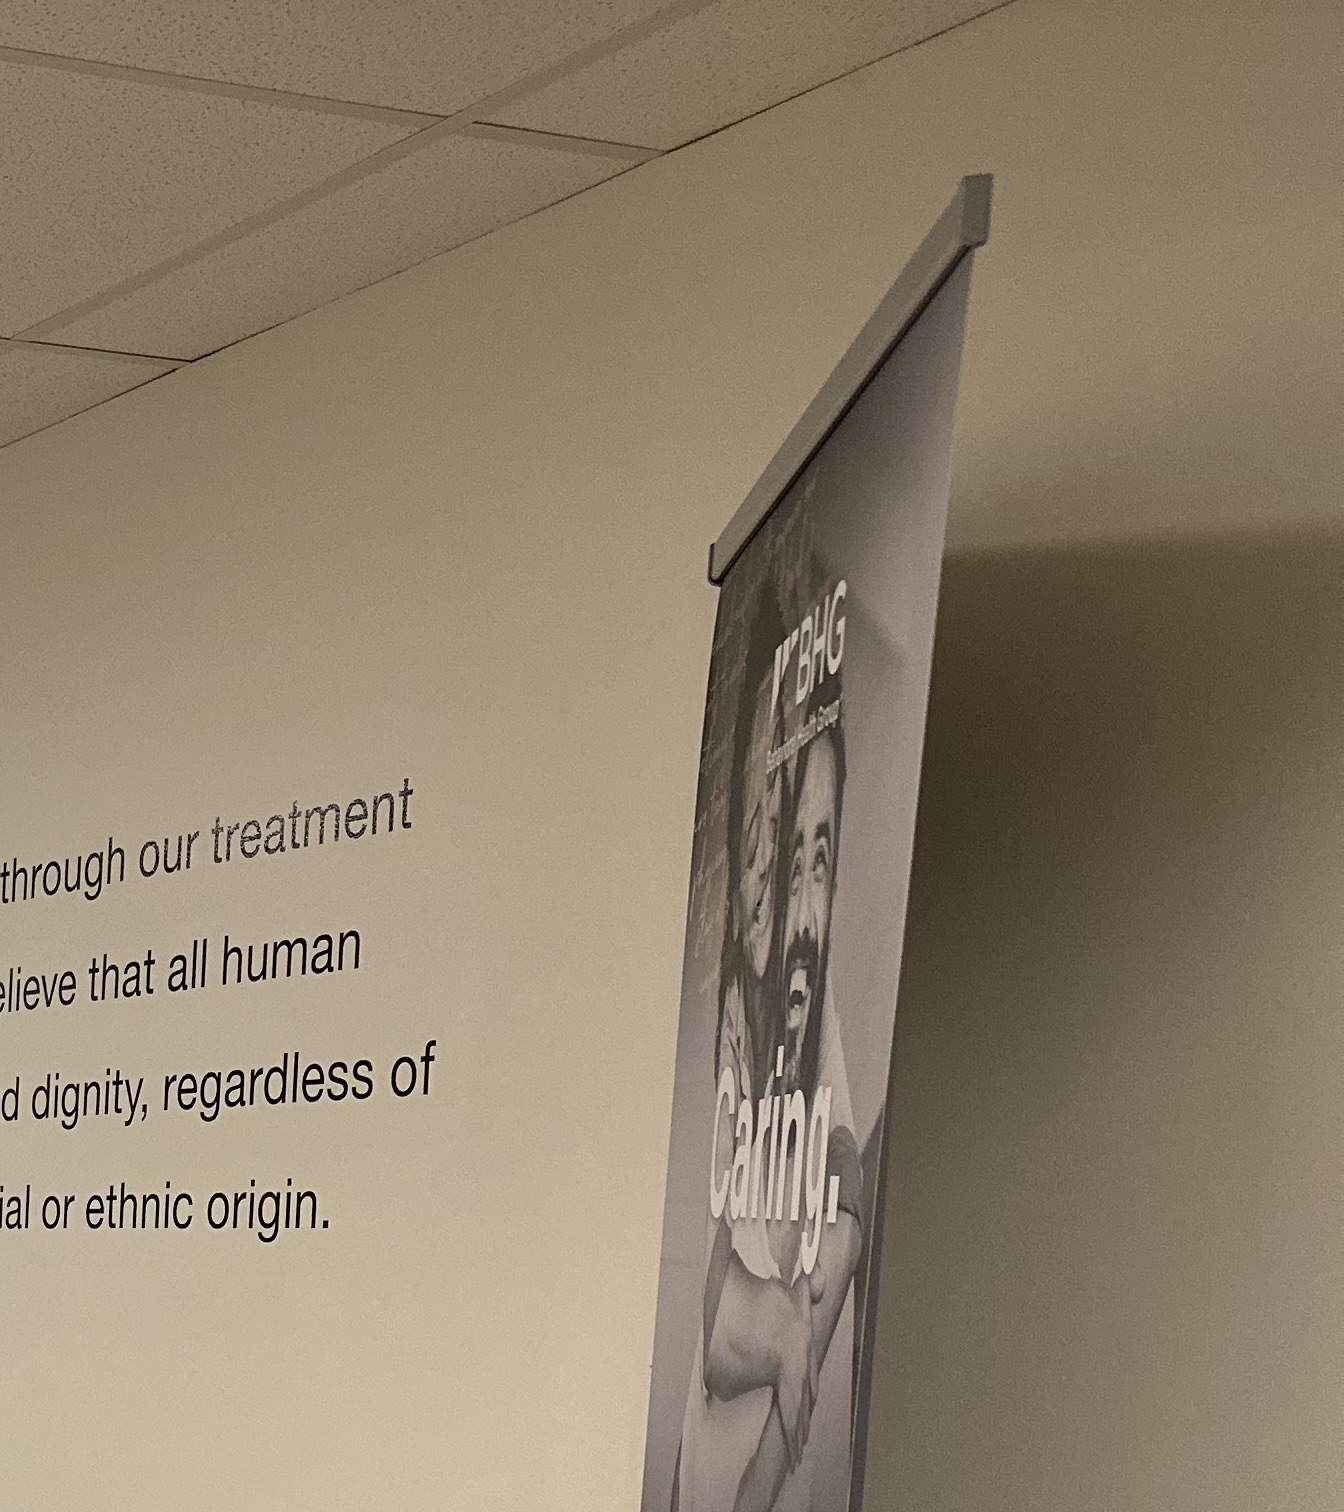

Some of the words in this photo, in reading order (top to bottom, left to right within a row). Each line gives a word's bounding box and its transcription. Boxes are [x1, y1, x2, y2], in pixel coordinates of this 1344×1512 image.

[796, 579, 848, 706] BHG
[0, 838, 125, 900] through
[139, 830, 199, 877] our
[212, 778, 414, 864] treatment
[88, 950, 155, 1002] that
[167, 940, 208, 992] all
[222, 929, 361, 985] human
[32, 1070, 148, 1129] dignity,
[163, 1052, 374, 1122] regardless
[390, 1041, 437, 1096] of
[41, 1195, 75, 1230] or
[85, 1183, 193, 1230] ethnic
[207, 1179, 331, 1243] origin.
[711, 1045, 840, 1275] Caring.
